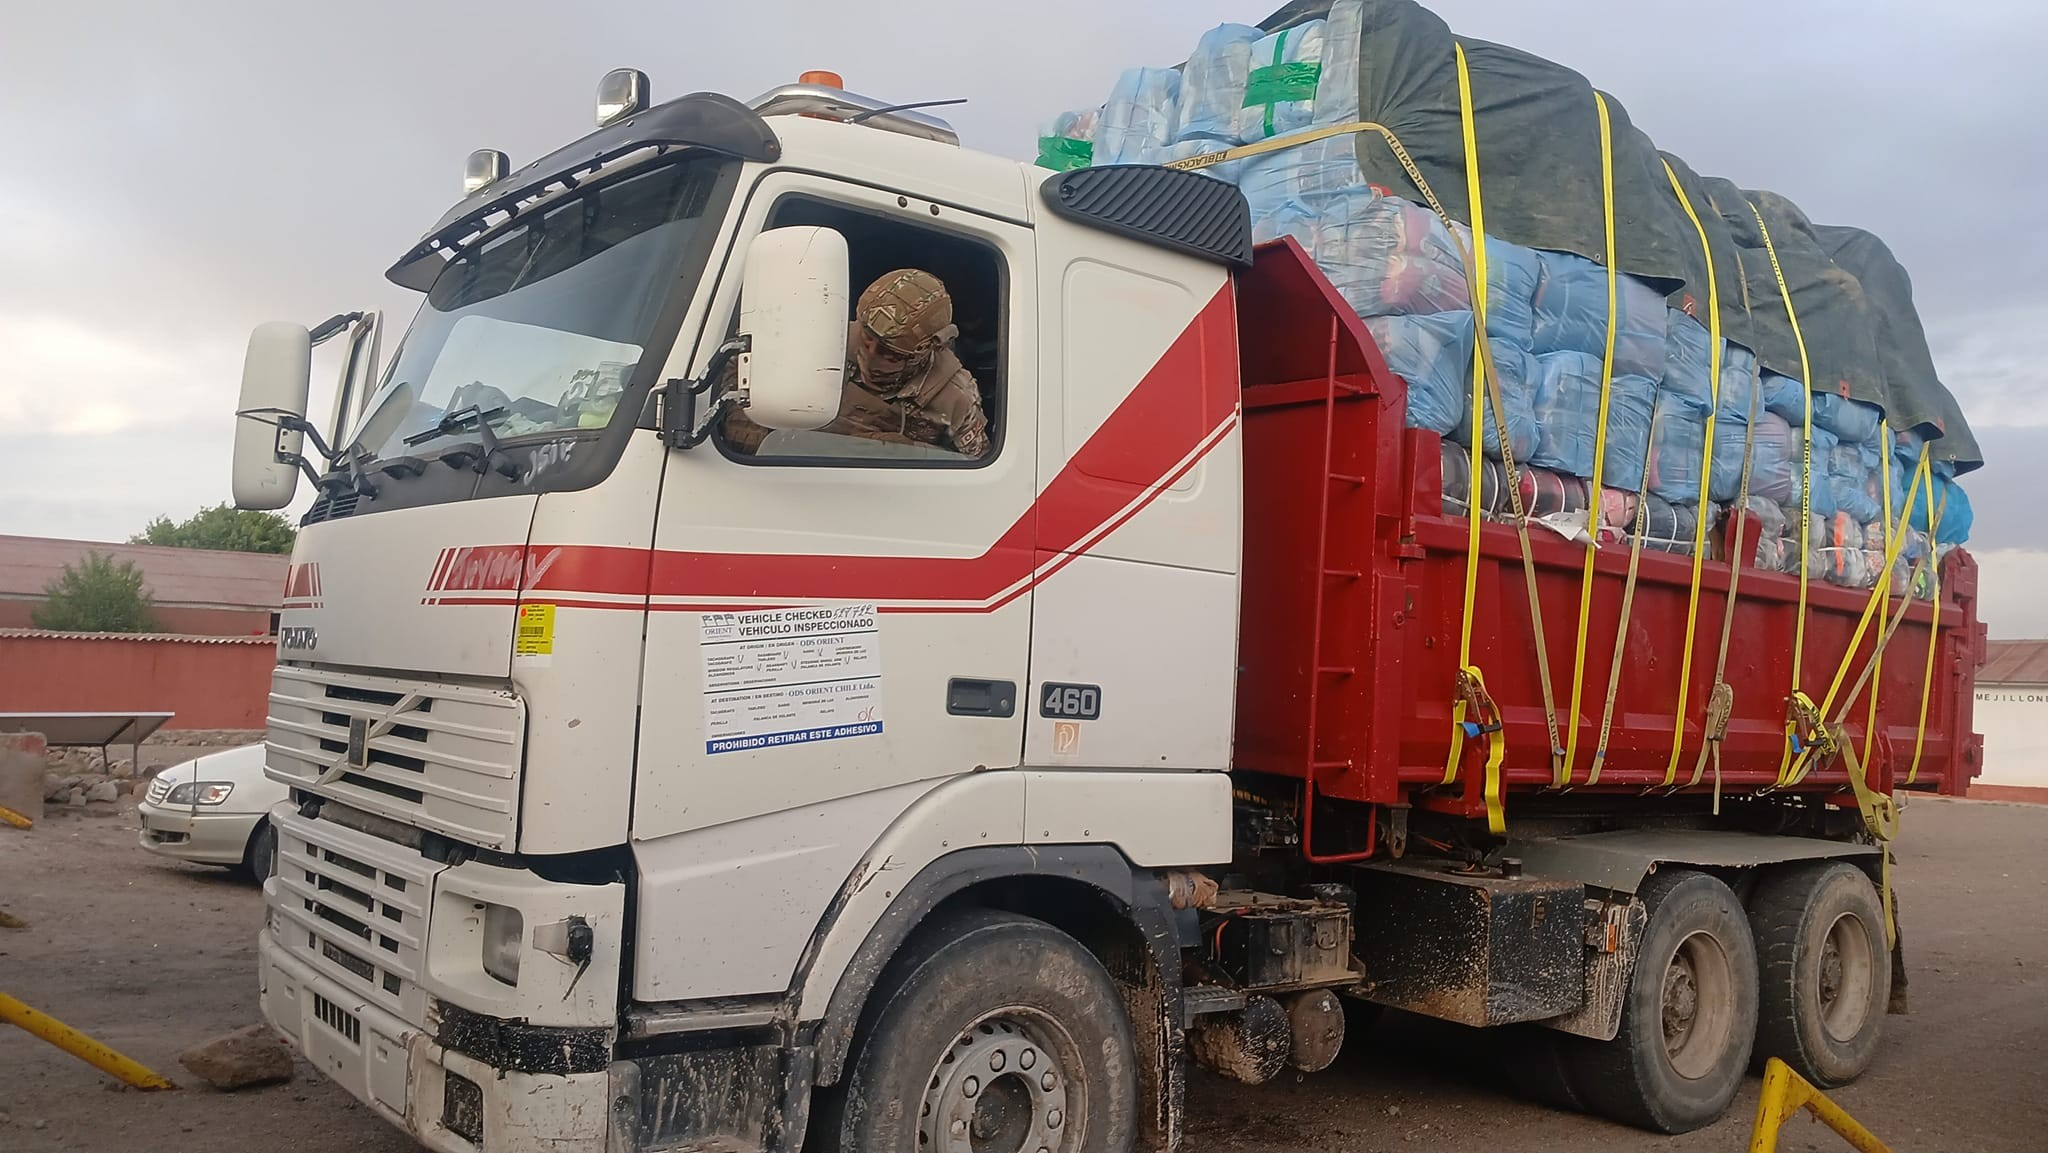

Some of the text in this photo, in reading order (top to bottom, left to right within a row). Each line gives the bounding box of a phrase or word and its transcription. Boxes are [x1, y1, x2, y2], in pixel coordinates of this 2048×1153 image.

[1387, 135, 1442, 214] BLACKSMITH
[1499, 425, 1521, 514] BLACKSMITH
[738, 610, 833, 625] VEHICLE CHECKED
[739, 618, 874, 636] VEHICULO INSPECCIONADO
[281, 626, 318, 650] VOLVO
[705, 627, 733, 636] ORIENT
[816, 637, 844, 645] ORIENT
[788, 689, 804, 697] ODS
[805, 686, 834, 696] ORIENT
[835, 684, 859, 693] CHILE
[1045, 688, 1098, 716] 460
[712, 724, 877, 751] PROHIBIDO RETIRAR ESTE ADHESIVO
